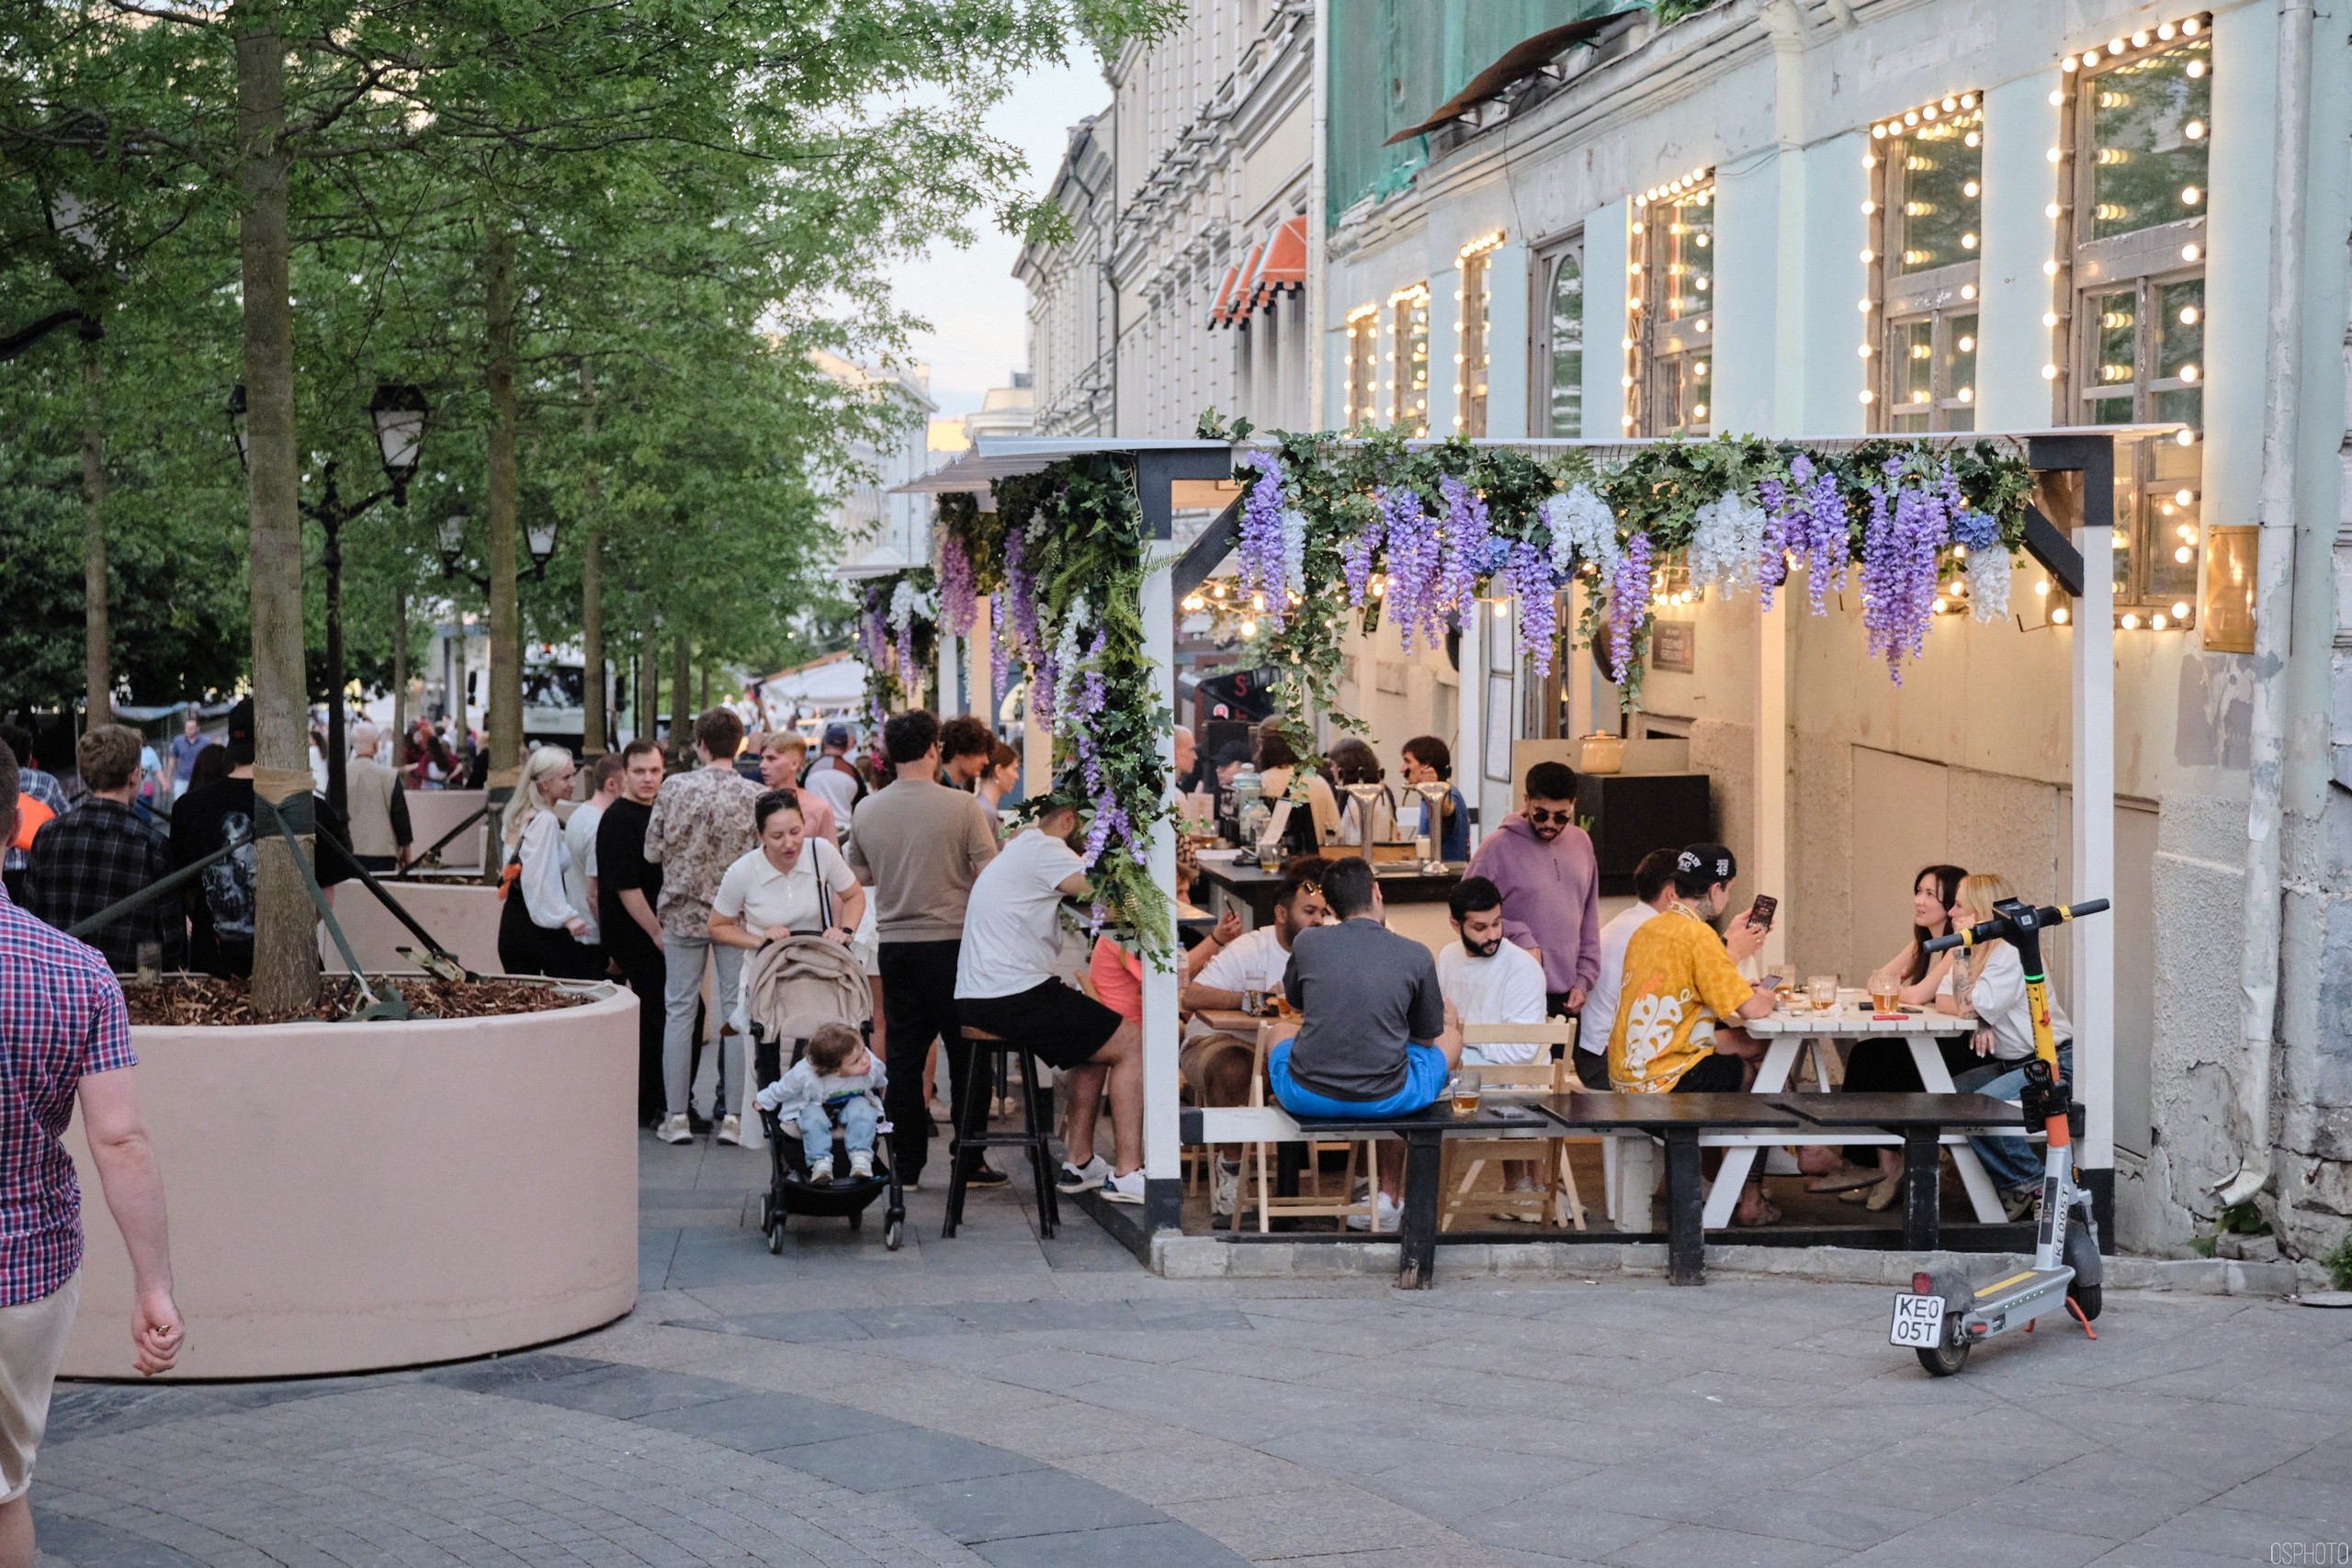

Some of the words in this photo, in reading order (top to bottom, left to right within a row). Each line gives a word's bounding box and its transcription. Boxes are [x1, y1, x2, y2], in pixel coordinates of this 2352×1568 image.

[1715, 865, 1728, 876] 49
[2055, 1186, 2069, 1257] KE005T
[1899, 1297, 1939, 1319] KE0
[1897, 1320, 1936, 1342] 05T
